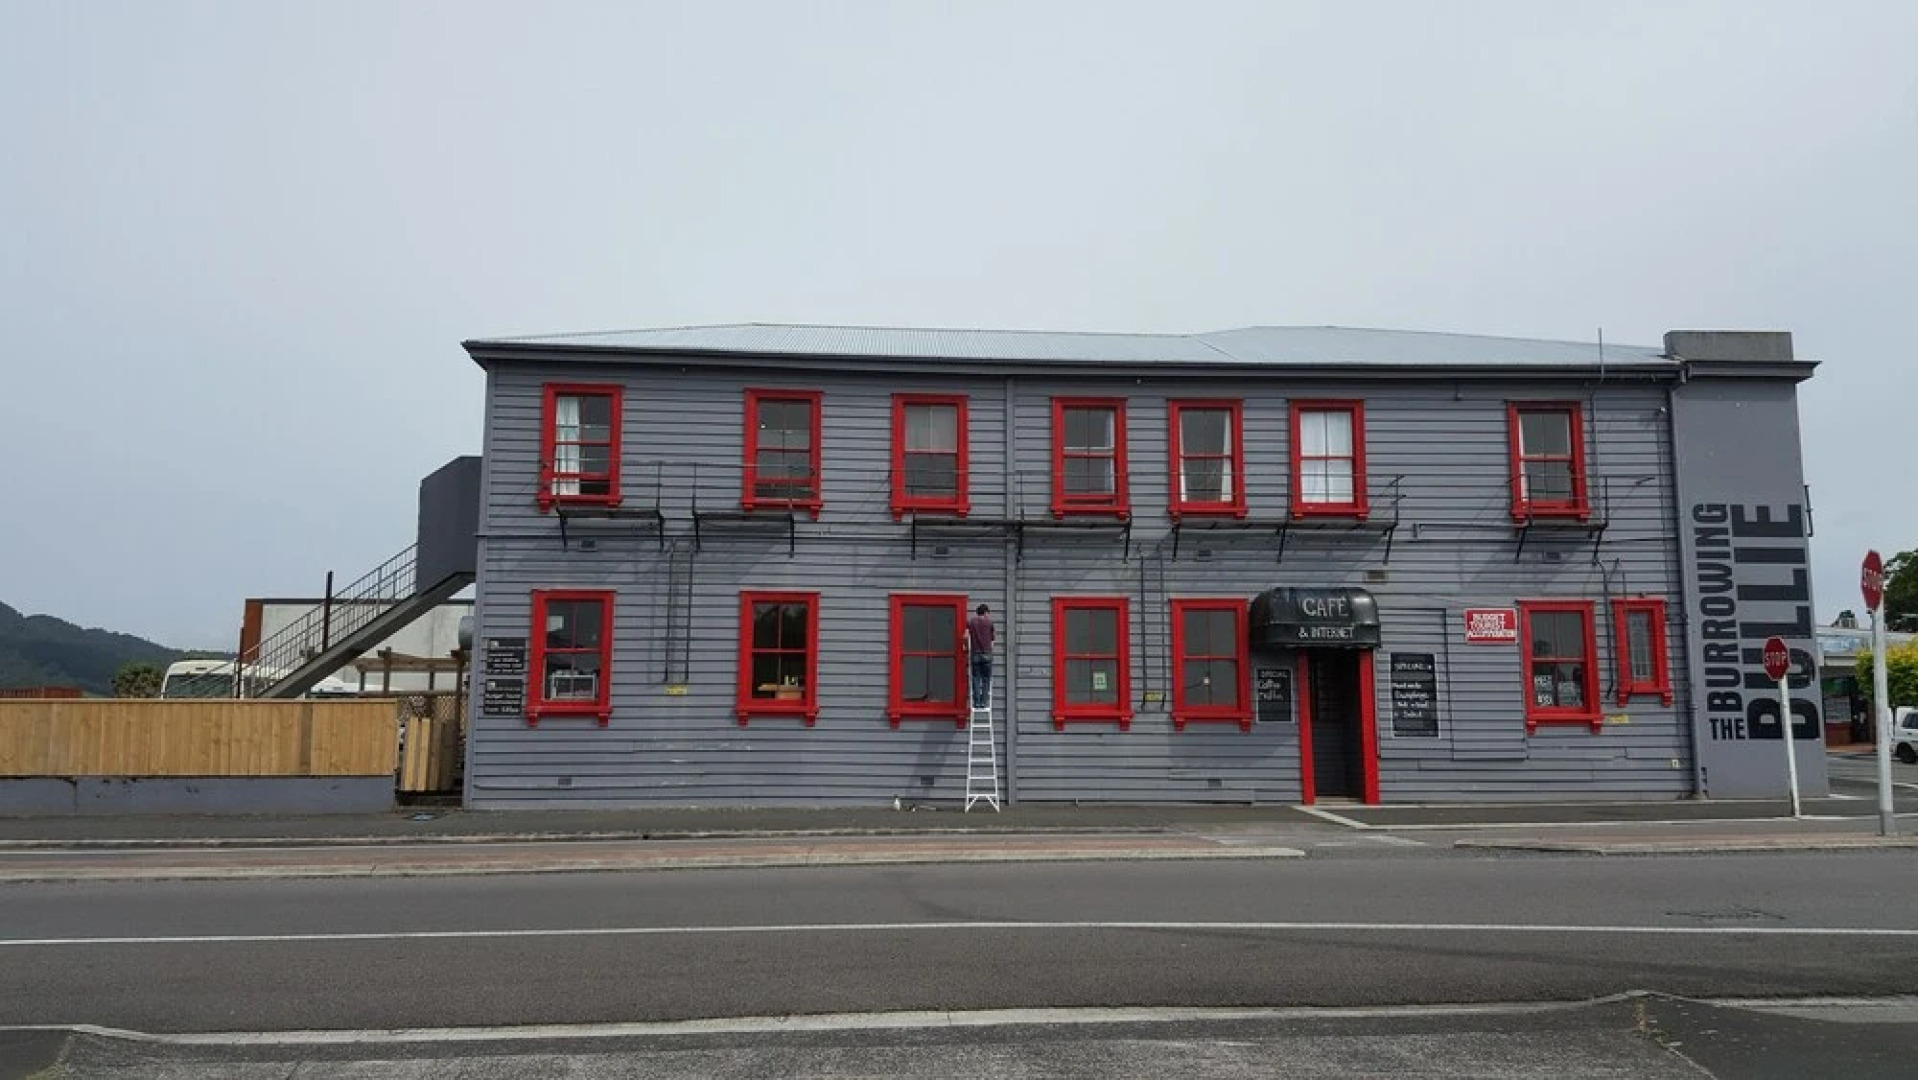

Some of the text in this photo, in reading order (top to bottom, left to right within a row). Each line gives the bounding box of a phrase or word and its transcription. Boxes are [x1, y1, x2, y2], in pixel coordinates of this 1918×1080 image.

[1298, 626, 1354, 638] & INTERNET
[1692, 503, 1746, 740] THE BURROWING
[1730, 504, 1820, 739] BULLIE
[1764, 651, 1788, 667] STOP
